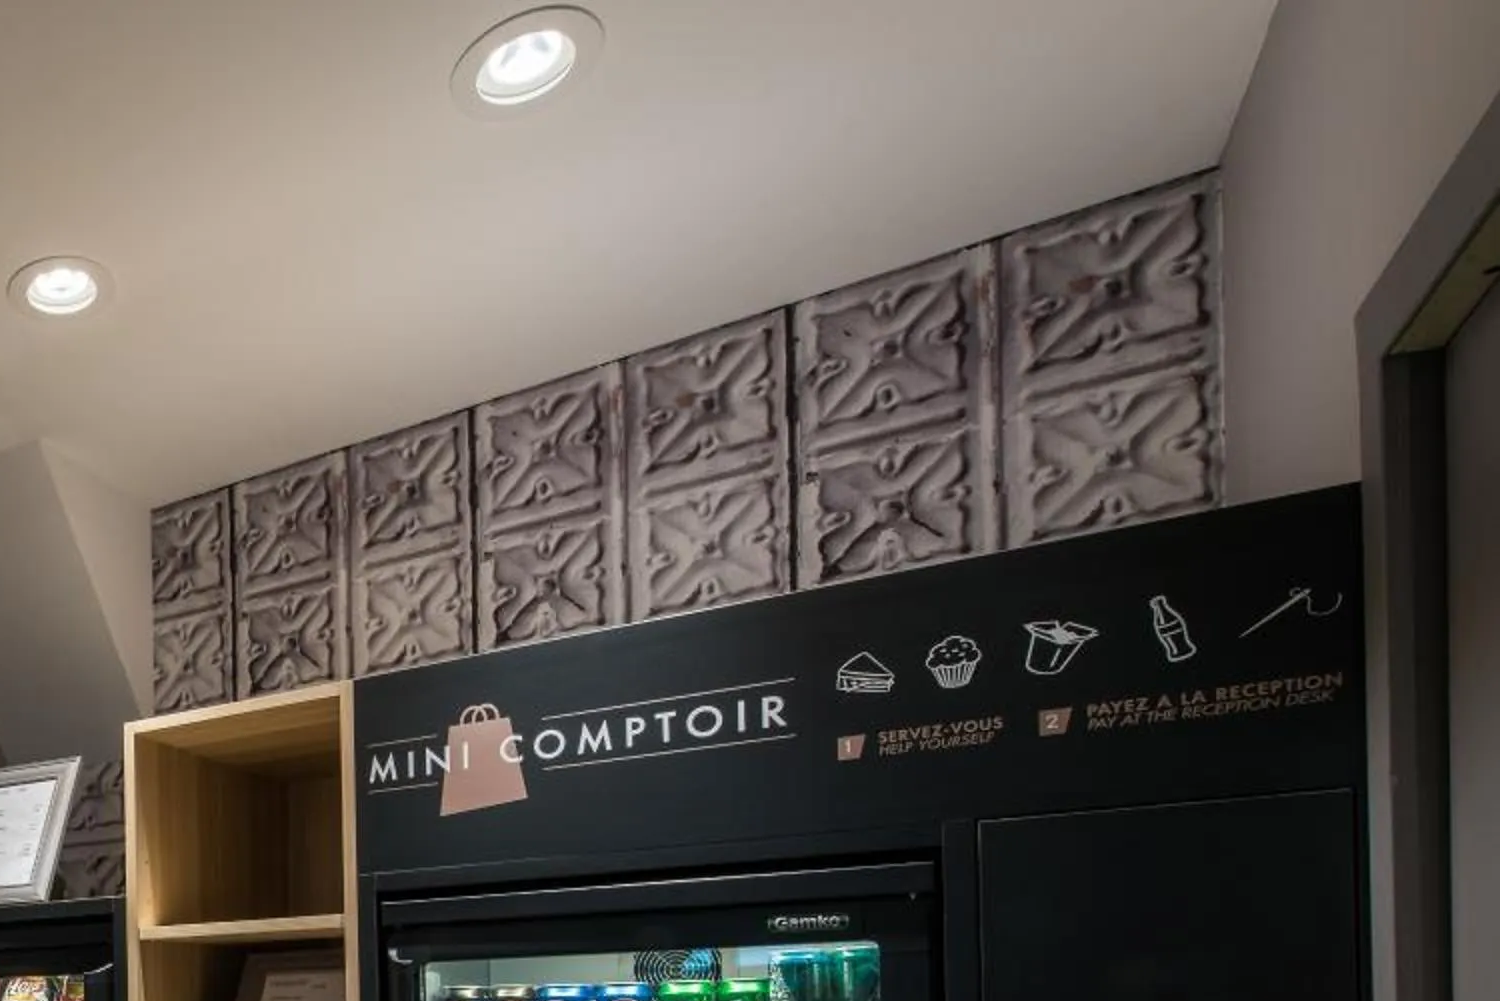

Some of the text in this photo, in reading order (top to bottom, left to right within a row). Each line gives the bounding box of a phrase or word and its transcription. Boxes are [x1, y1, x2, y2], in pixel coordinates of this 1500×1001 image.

[1086, 671, 1343, 718] PAYEZ A LA RECEPTION
[1087, 687, 1335, 731] PAY AT THE RECEPTION DESK
[878, 717, 1004, 744] SERVEZ-VOUS
[1045, 713, 1059, 729] 2
[369, 695, 788, 785] MINI COMPTOIR
[879, 730, 996, 757] HELP YOURSELF
